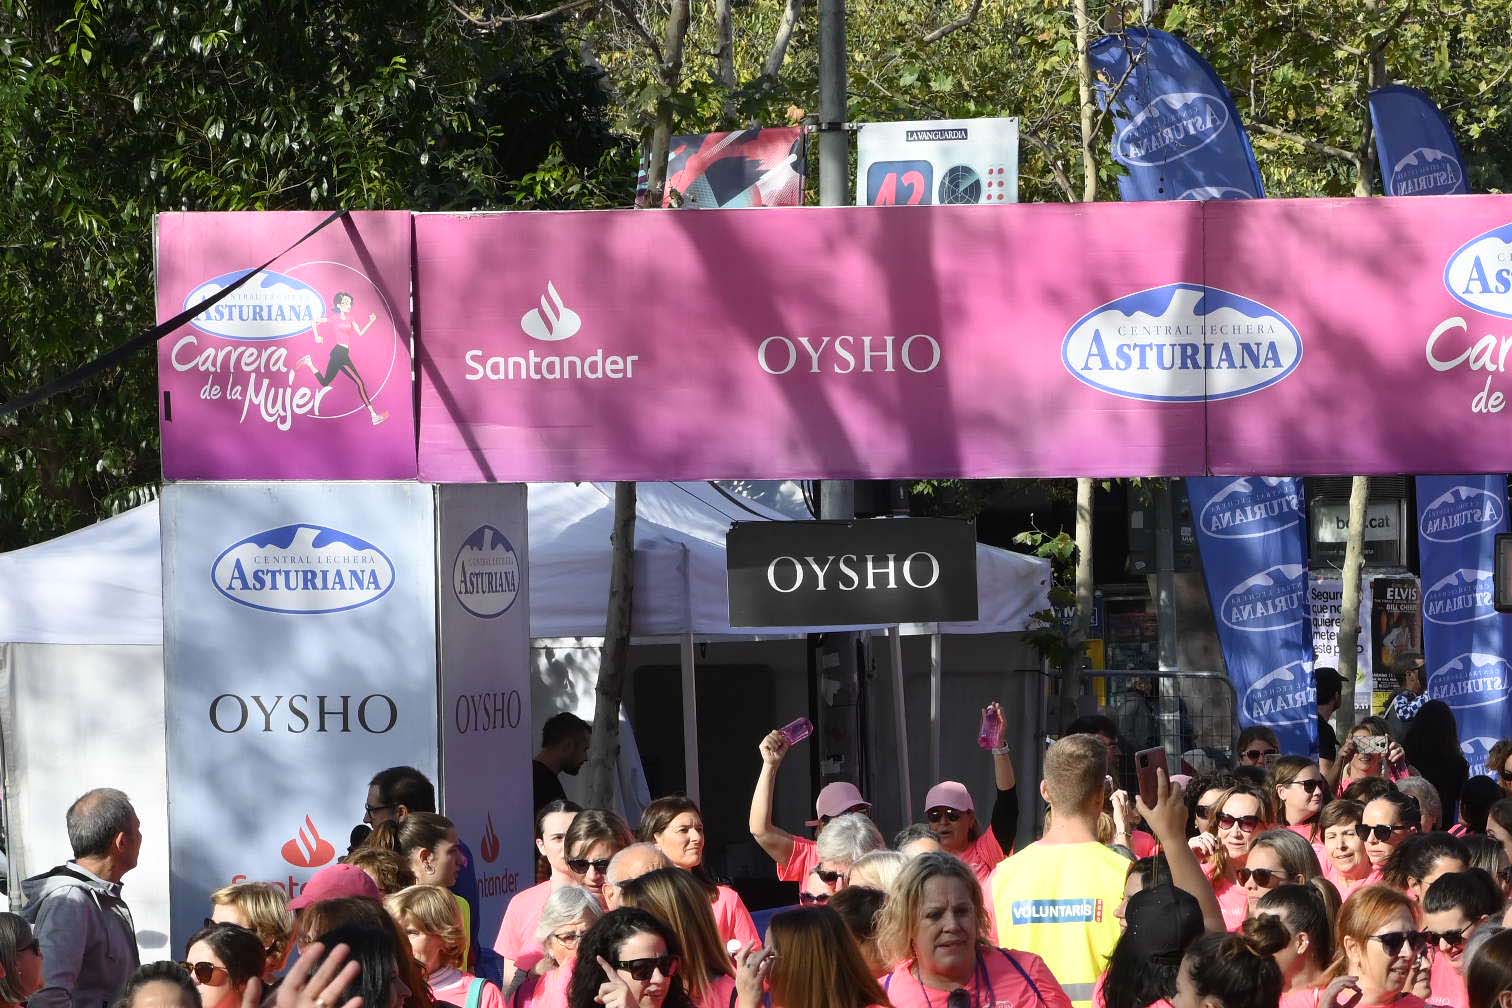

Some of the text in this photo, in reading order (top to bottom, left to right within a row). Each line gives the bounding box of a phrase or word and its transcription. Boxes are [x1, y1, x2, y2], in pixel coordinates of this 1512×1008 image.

[1117, 324, 1276, 336] CENTRAL LECHERA
[171, 335, 288, 373] Carrera
[464, 349, 639, 382] Santander
[757, 334, 941, 376] OYSHO
[1084, 330, 1283, 373] ASTURIANA
[200, 370, 333, 432] de la Mujer
[1471, 372, 1505, 414] de
[226, 557, 381, 592] ASTURIANA
[254, 554, 376, 565] CENTRAL LECHERA
[767, 551, 940, 593] OYSHO
[458, 560, 516, 596] ASTURIANA
[1386, 587, 1417, 600] ELVIS
[1312, 604, 1328, 616] que
[1313, 630, 1340, 641] mete
[208, 693, 399, 735] OYSHO
[456, 690, 521, 735] OYSHO
[475, 868, 519, 900] ntander
[1013, 904, 1092, 919] VOLUNTARIS
